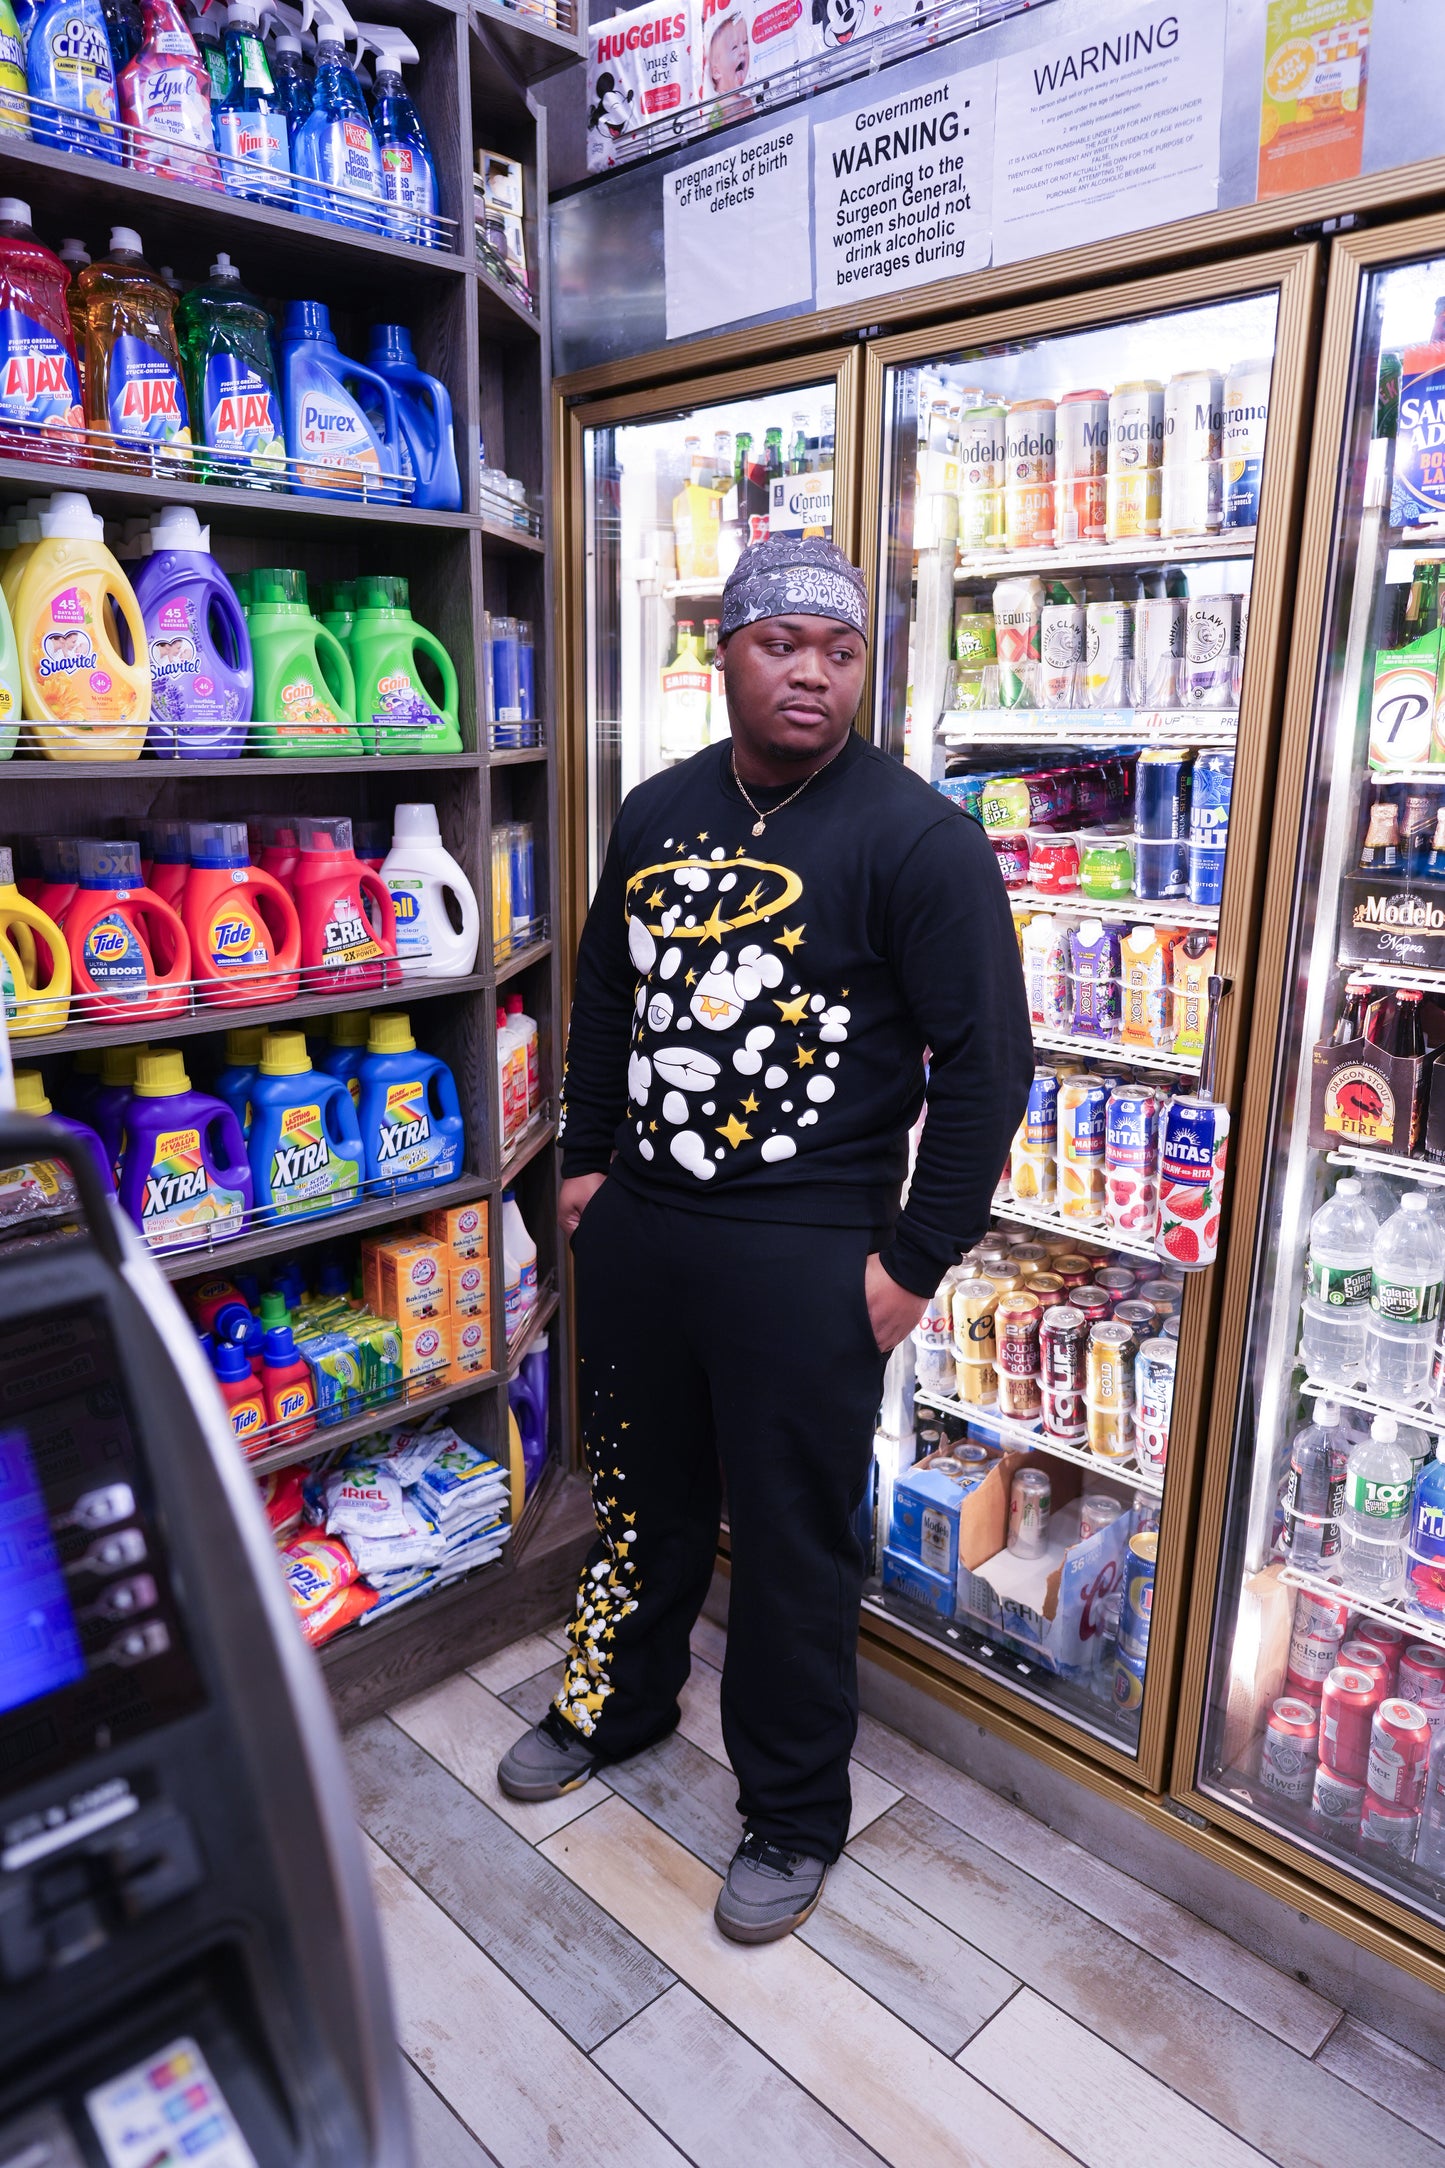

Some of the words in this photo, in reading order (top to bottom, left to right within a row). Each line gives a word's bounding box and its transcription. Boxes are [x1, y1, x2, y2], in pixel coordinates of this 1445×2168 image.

[597, 13, 687, 64] HUGGIES
[53, 34, 110, 67] CLEAN
[1033, 16, 1179, 95] WARNING
[1276, 51, 1303, 77] TRY
[1278, 61, 1307, 87] NOW
[148, 69, 194, 104] Lysol
[855, 84, 950, 131] Government
[673, 115, 685, 136] 6
[1026, 146, 1056, 161] VIOLATION
[1056, 137, 1092, 153] PUNISHABLE
[1092, 129, 1113, 143] UNDER
[1113, 125, 1126, 134] LAW
[1126, 119, 1140, 131] FOR
[1139, 116, 1154, 127] ANY
[1153, 106, 1180, 122] PERSON
[236, 130, 280, 157] Windex
[832, 100, 971, 179] WARNING:
[1007, 165, 1044, 182] TWENTY-ONE
[1053, 156, 1080, 169] PRESENT
[1080, 150, 1094, 160] ANY
[1093, 143, 1120, 157] WRITTEN
[1119, 132, 1150, 149] EVIDENCE
[1159, 124, 1174, 135] AGE
[1174, 117, 1196, 130] WHICH
[348, 149, 370, 168] Glass
[675, 156, 737, 195] pregnancy
[740, 133, 794, 165] because
[345, 161, 374, 183] Cleaner
[385, 174, 410, 189] Glass
[680, 190, 692, 207] of
[694, 184, 712, 201] the
[716, 171, 739, 191] risk
[742, 164, 756, 182] of
[758, 152, 788, 176] birth
[839, 171, 914, 206] According
[919, 165, 934, 181] to
[939, 156, 964, 175] the
[1046, 186, 1078, 201] PURCHASE
[1078, 182, 1091, 193] ANY
[1090, 173, 1124, 189] ALCOHOLIC
[710, 187, 755, 213] defects
[836, 197, 897, 227] Surgeon
[902, 174, 967, 207] General,
[833, 222, 884, 248] women
[888, 202, 940, 232] should
[945, 193, 971, 215] not
[846, 241, 882, 264] drink
[886, 221, 956, 252] alcoholic
[836, 255, 910, 286] beverages
[915, 240, 966, 265] during
[5, 356, 69, 402] AJAX
[122, 379, 181, 423] AJAX
[166, 413, 182, 421] ULTRA
[217, 394, 272, 437] AJAX
[304, 406, 356, 433] Purex
[959, 440, 1006, 464] odelo
[789, 493, 832, 515] Coron
[803, 511, 827, 524] Extra
[59, 600, 77, 610] 45
[164, 608, 182, 618] 45
[54, 614, 84, 622] FRESHNESS
[1002, 611, 1033, 625] EQUIS
[1195, 610, 1225, 628] CLAW
[1042, 623, 1057, 652] WHITE
[1056, 619, 1082, 636] CLAW
[1168, 615, 1184, 647] WHITE
[40, 652, 97, 677] Suavitel
[151, 658, 200, 682] Suavitel
[96, 679, 107, 688] 46
[199, 682, 209, 690] 46
[377, 676, 411, 694] Gain
[664, 674, 708, 691] SMIRNOFF
[282, 684, 314, 704] Gain
[1377, 694, 1429, 743] P
[1180, 775, 1188, 813] SELTZER
[984, 799, 999, 815] BIG
[985, 808, 1010, 824] SIPZ
[1172, 795, 1180, 819] LIGHT
[1171, 819, 1180, 840] BUD
[94, 854, 135, 875] OXI
[393, 897, 416, 918] all
[1365, 896, 1444, 928] Modelo
[214, 921, 252, 951] Tide
[325, 918, 368, 948] ERA
[93, 933, 125, 956] Tide
[254, 949, 265, 958] 6X
[355, 948, 378, 959] POWER
[344, 952, 356, 962] 2X
[90, 967, 109, 977] OXI
[109, 966, 144, 976] BOOST
[1332, 1060, 1360, 1074] ORIGINAL
[1361, 1061, 1390, 1082] JAMAICAN
[388, 1088, 406, 1100] MORE
[1329, 1071, 1365, 1094] DRAGON
[1367, 1075, 1391, 1102] STOUT
[284, 1111, 311, 1126] LASTING
[286, 1115, 317, 1132] FRESHNESS
[1342, 1121, 1377, 1137] FIRE
[160, 1131, 195, 1149] AMERICA'S
[168, 1136, 196, 1150] VALUE
[376, 1115, 431, 1162] XTRA
[1107, 1129, 1150, 1146] RITAS
[173, 1143, 192, 1154] BRAND
[1165, 1141, 1211, 1164] RITAS
[271, 1136, 330, 1188] XTRA
[304, 1178, 329, 1194] BOOSTER
[309, 1173, 328, 1185] SCENT
[143, 1166, 209, 1218] XTRA
[146, 1217, 175, 1227] Calypso
[146, 1224, 167, 1233] Fresh
[452, 1237, 472, 1248] Baking
[471, 1234, 484, 1244] Soda
[405, 1291, 428, 1304] Baking
[427, 1286, 444, 1298] Soda
[455, 1295, 474, 1306] Baking
[473, 1291, 486, 1302] Soda
[1379, 1284, 1416, 1299] Poland
[1379, 1296, 1417, 1308] Spring
[1006, 1320, 1037, 1337] 24
[1001, 1349, 1039, 1362] ENGLISH
[1006, 1343, 1035, 1353] OLDE
[409, 1363, 431, 1375] Baking
[430, 1357, 447, 1368] Soda
[1101, 1362, 1113, 1398] GOLD
[280, 1393, 305, 1418] Tide
[232, 1409, 258, 1434] Tide
[338, 1486, 389, 1501] ARIEL
[1364, 1498, 1389, 1508] Poland
[1365, 1505, 1390, 1513] Spring
[923, 1515, 950, 1539] Modelo
[1070, 1557, 1086, 1574] 36
